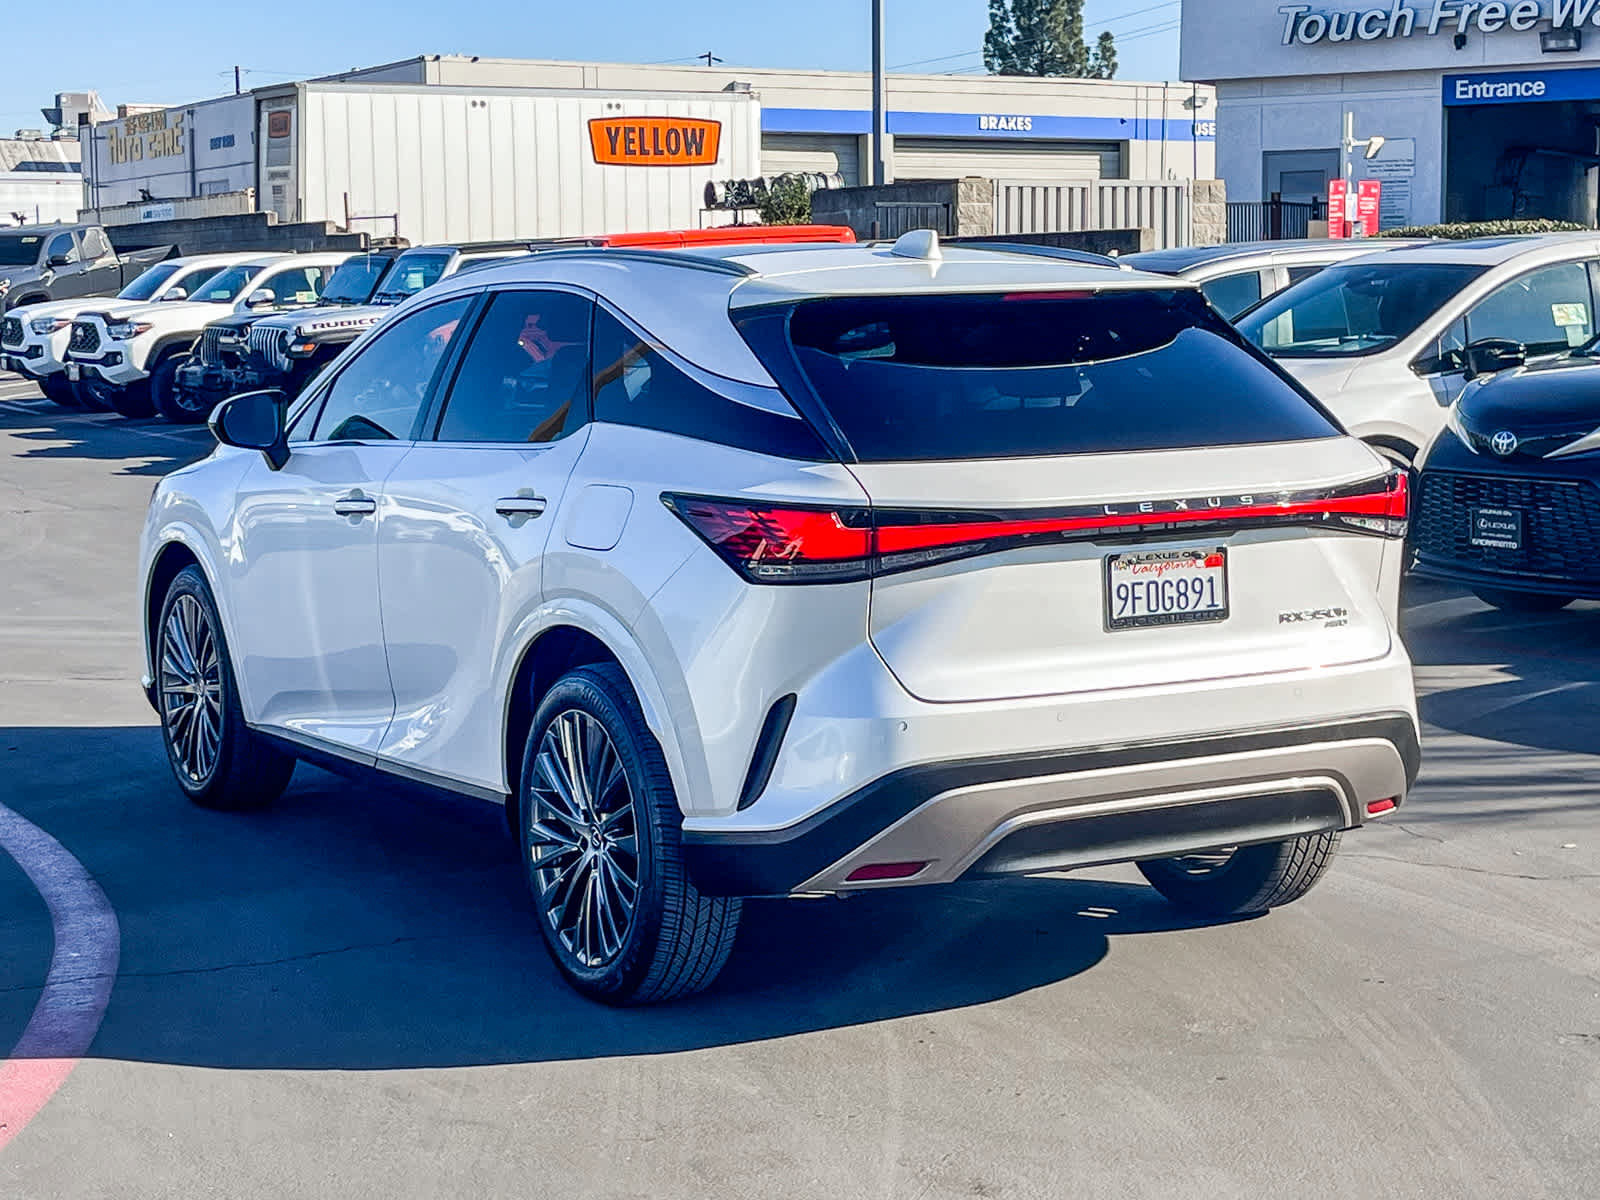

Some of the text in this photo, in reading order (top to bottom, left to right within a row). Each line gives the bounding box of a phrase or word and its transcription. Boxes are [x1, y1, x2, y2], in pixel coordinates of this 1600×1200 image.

[1279, 0, 1415, 46] Touch
[1427, 0, 1540, 36] Free
[1455, 79, 1546, 100] Entrance
[978, 115, 1033, 132] BRAKES
[605, 126, 705, 156] YELLOW
[1104, 495, 1254, 515] LEXUS
[1136, 551, 1179, 561] LEXUS
